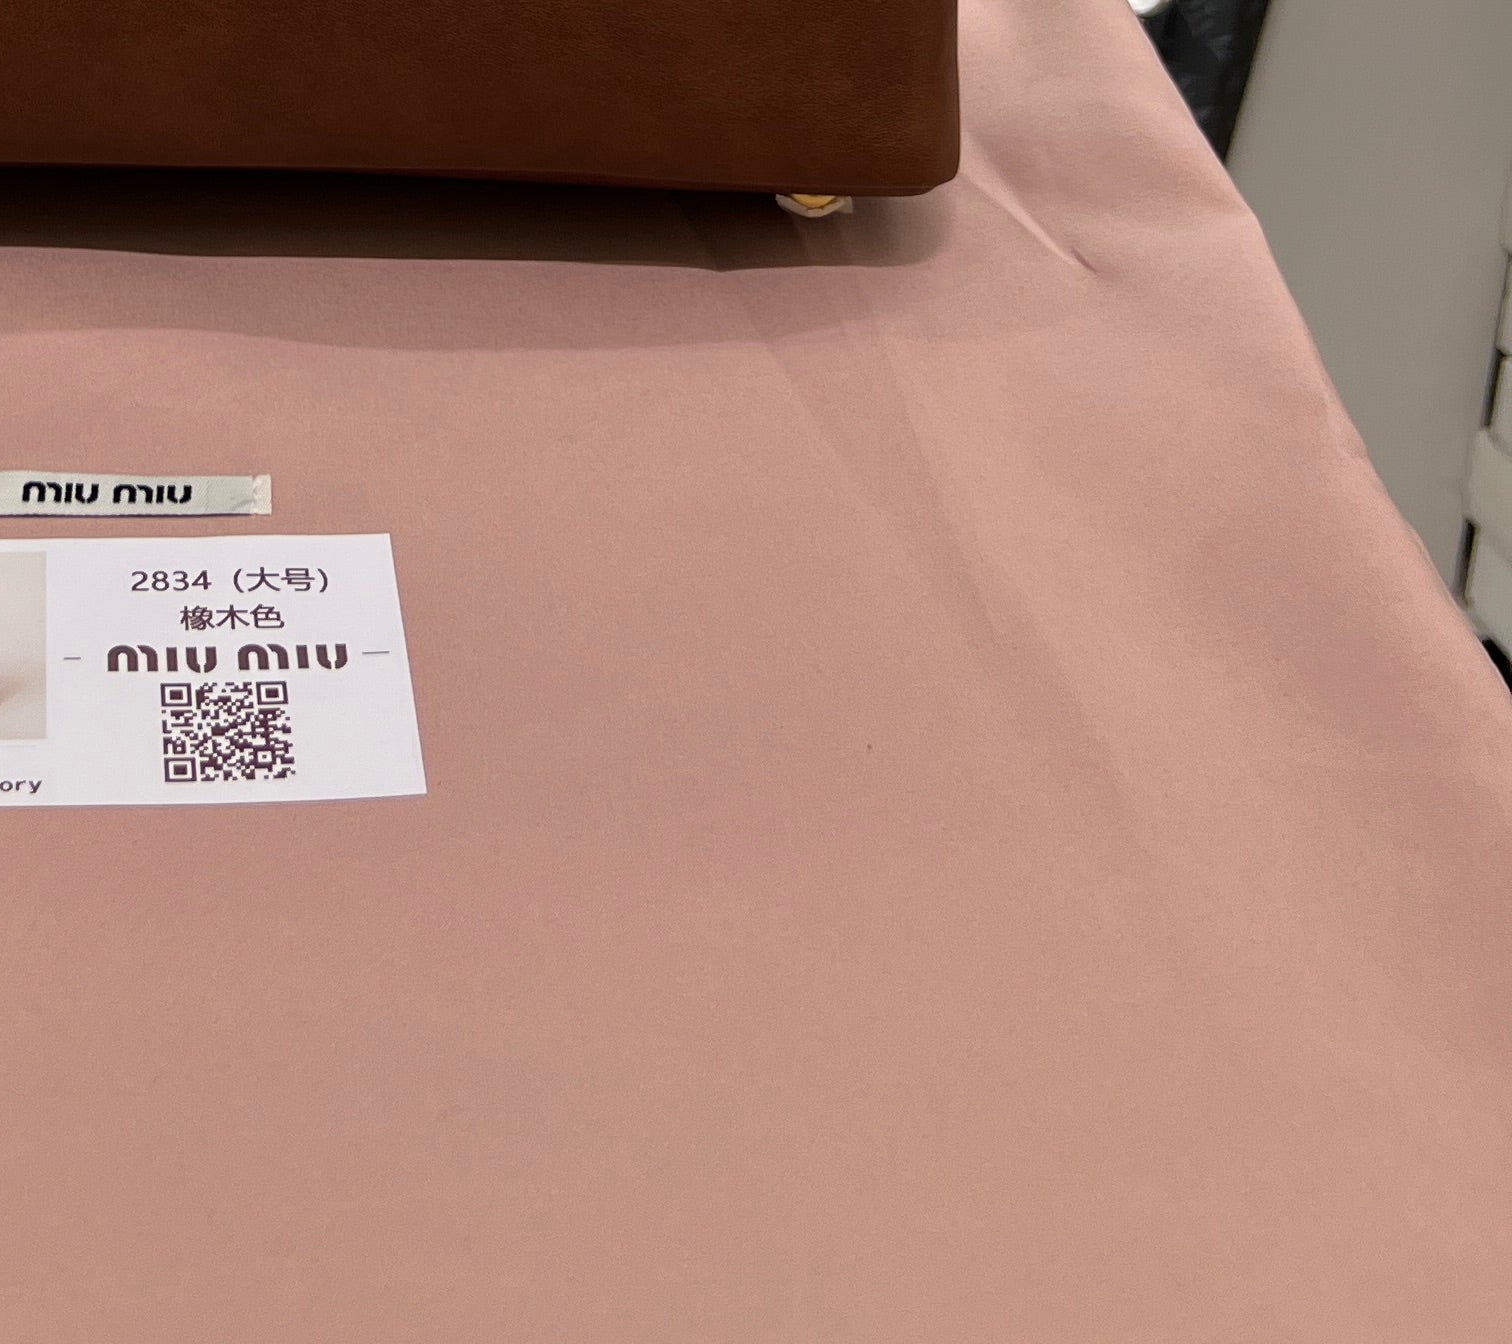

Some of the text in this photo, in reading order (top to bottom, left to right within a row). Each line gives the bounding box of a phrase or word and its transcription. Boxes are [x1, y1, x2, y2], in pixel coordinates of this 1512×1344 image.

[130, 569, 213, 592] 2834
[179, 603, 286, 631] 橡木色
